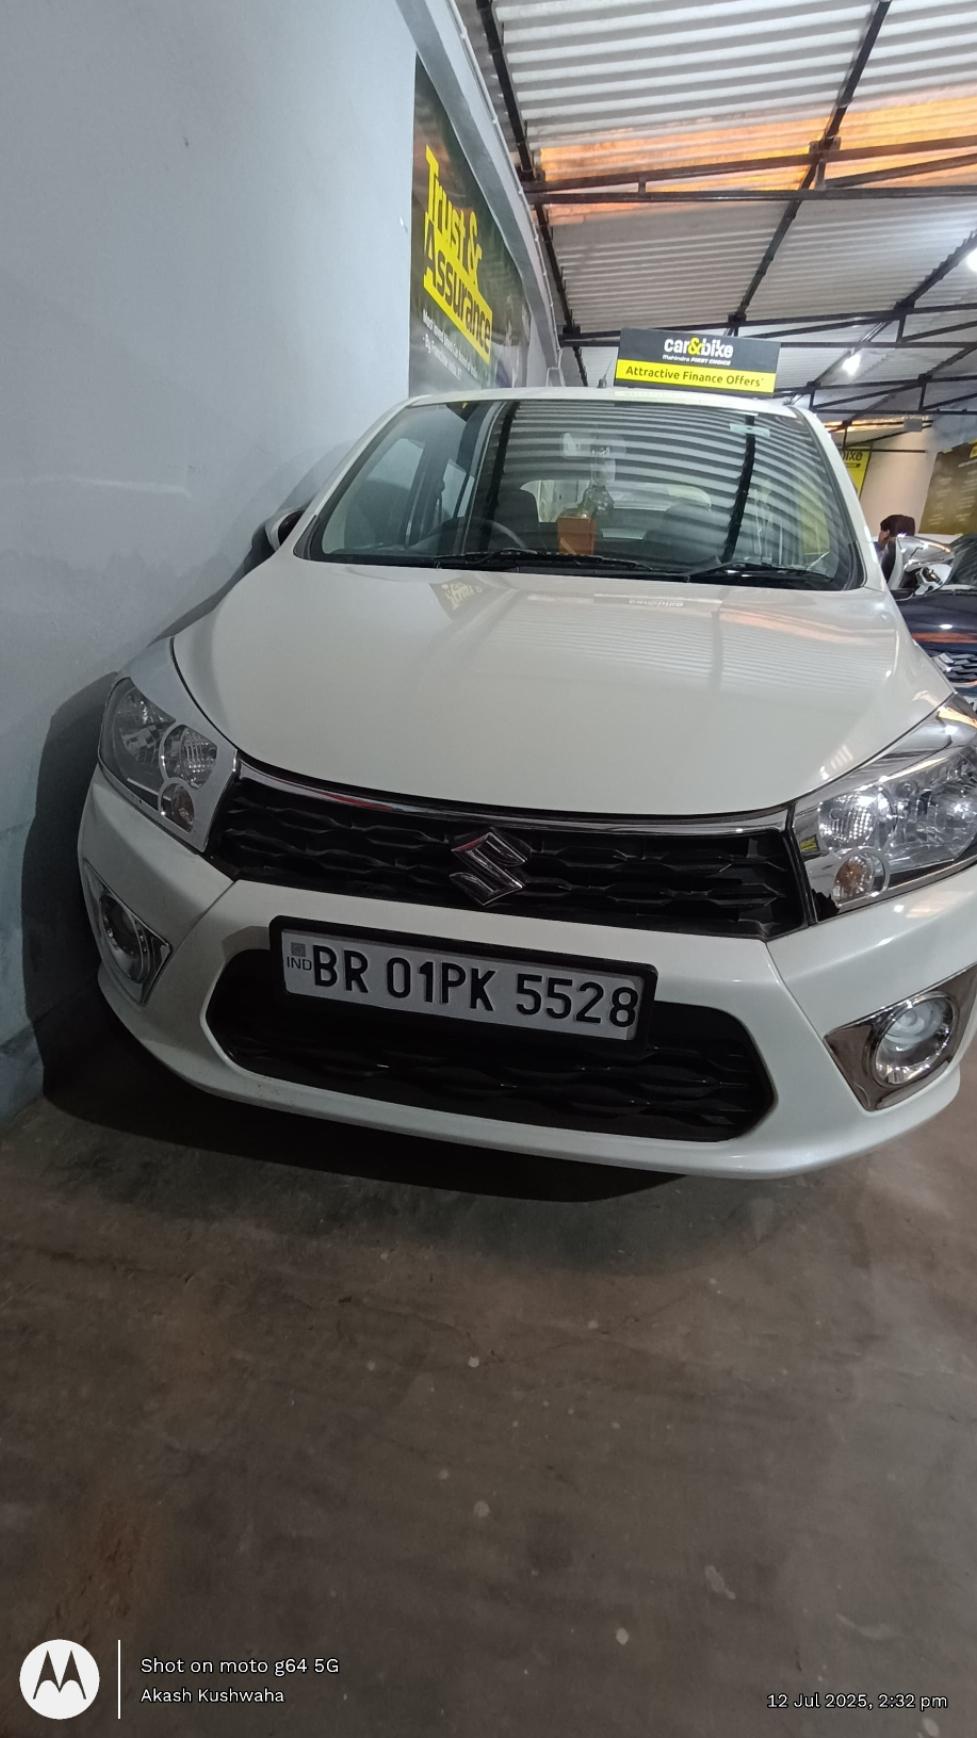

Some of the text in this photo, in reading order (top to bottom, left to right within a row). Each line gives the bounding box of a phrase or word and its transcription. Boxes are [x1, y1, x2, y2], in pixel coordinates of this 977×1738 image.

[426, 144, 466, 261] Trust
[424, 219, 491, 355] Assurance
[625, 365, 680, 380] Attractive
[682, 371, 723, 384] Finance
[664, 336, 734, 358] car&bike
[287, 945, 640, 1028] IND BR 01PK 5528
